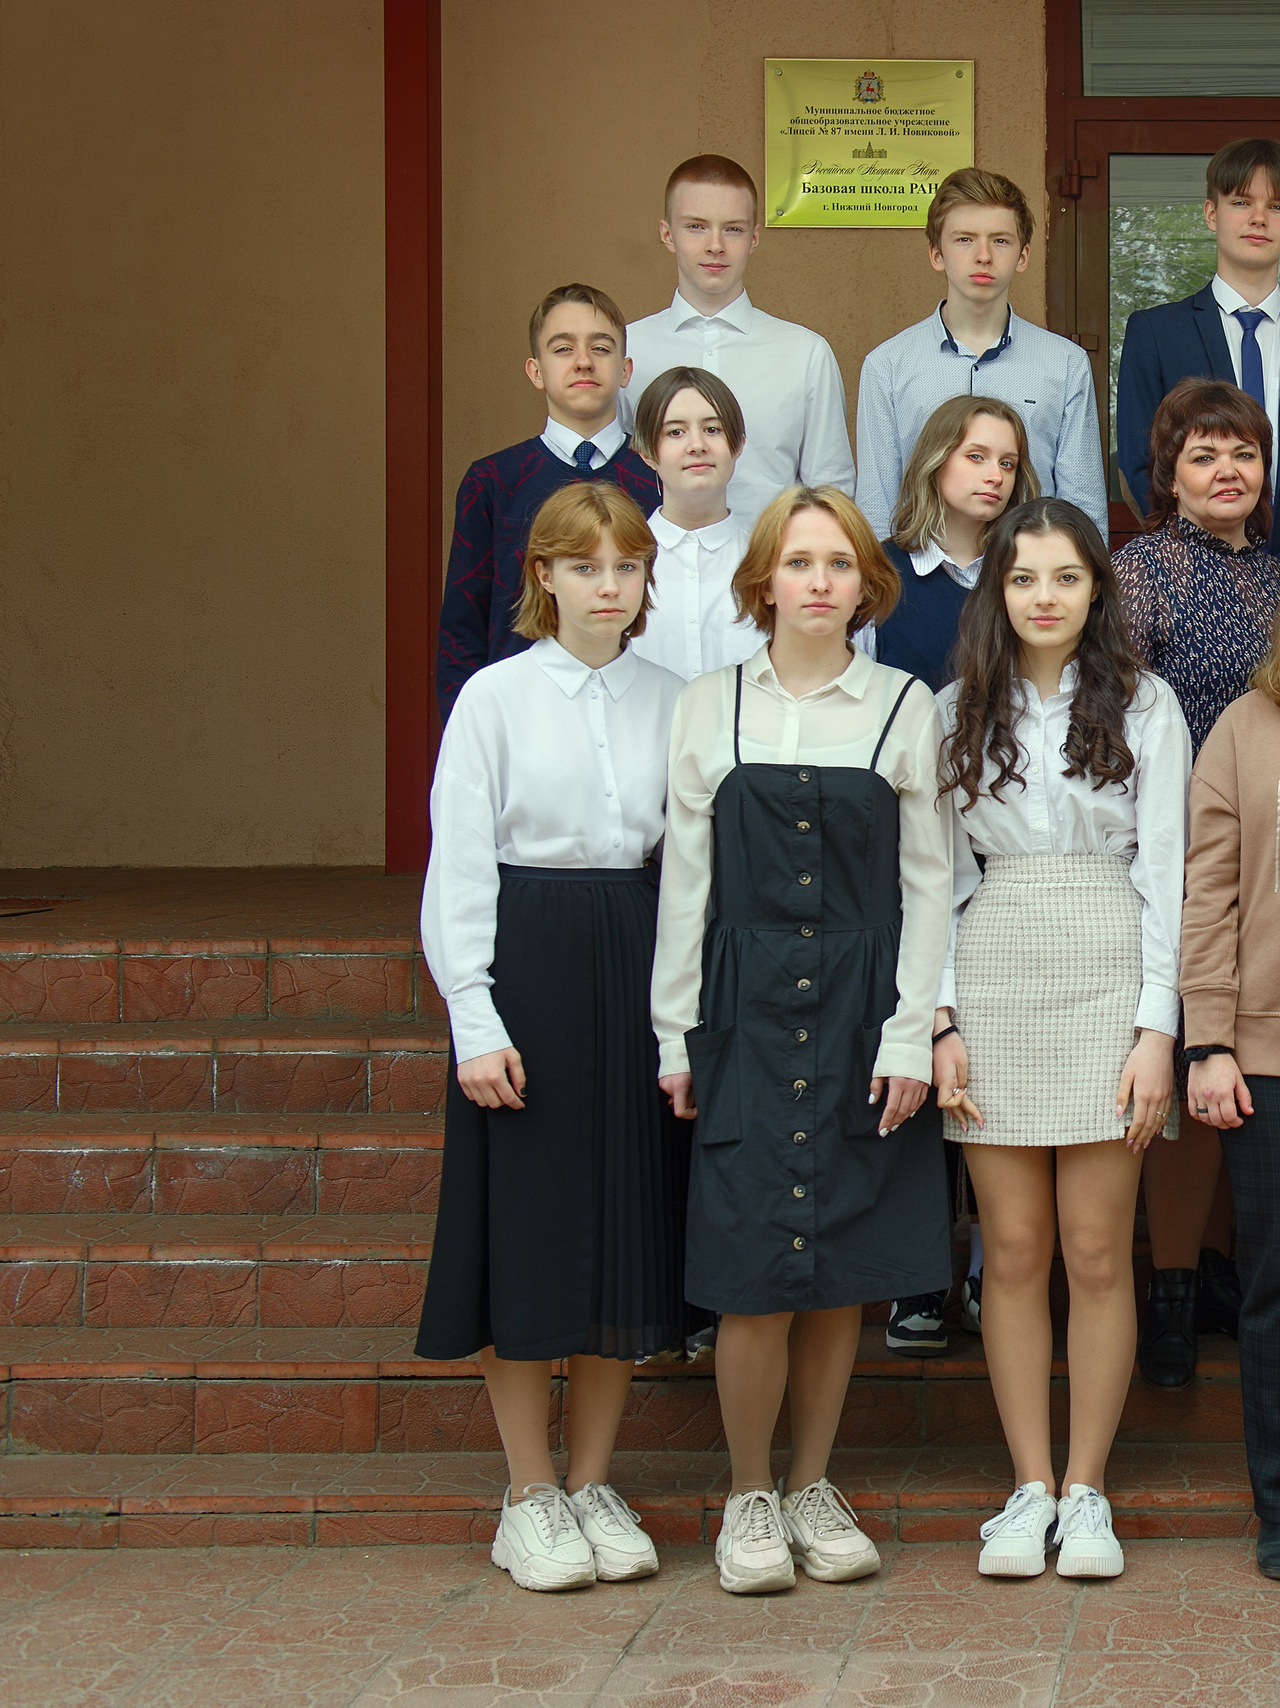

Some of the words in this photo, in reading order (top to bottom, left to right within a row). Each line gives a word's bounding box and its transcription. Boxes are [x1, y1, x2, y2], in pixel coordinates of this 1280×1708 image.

[805, 106, 882, 117] Муниципальное
[884, 107, 935, 116] бюджетное
[790, 117, 891, 127] общеобразовательное
[894, 118, 950, 127] учреждение
[780, 127, 815, 137] «Лицей
[818, 127, 828, 135] №
[831, 127, 841, 135] 87
[876, 128, 887, 136] Л.
[890, 127, 900, 136] И.
[903, 127, 960, 137] Новиковой»
[801, 159, 854, 175] Российская
[857, 161, 906, 181] Академия
[907, 160, 939, 181] Наук
[802, 182, 856, 194] Базовая
[861, 184, 905, 194] школа
[910, 183, 938, 194] РАН
[832, 203, 871, 211] Нижний
[874, 203, 918, 212] Новгород
